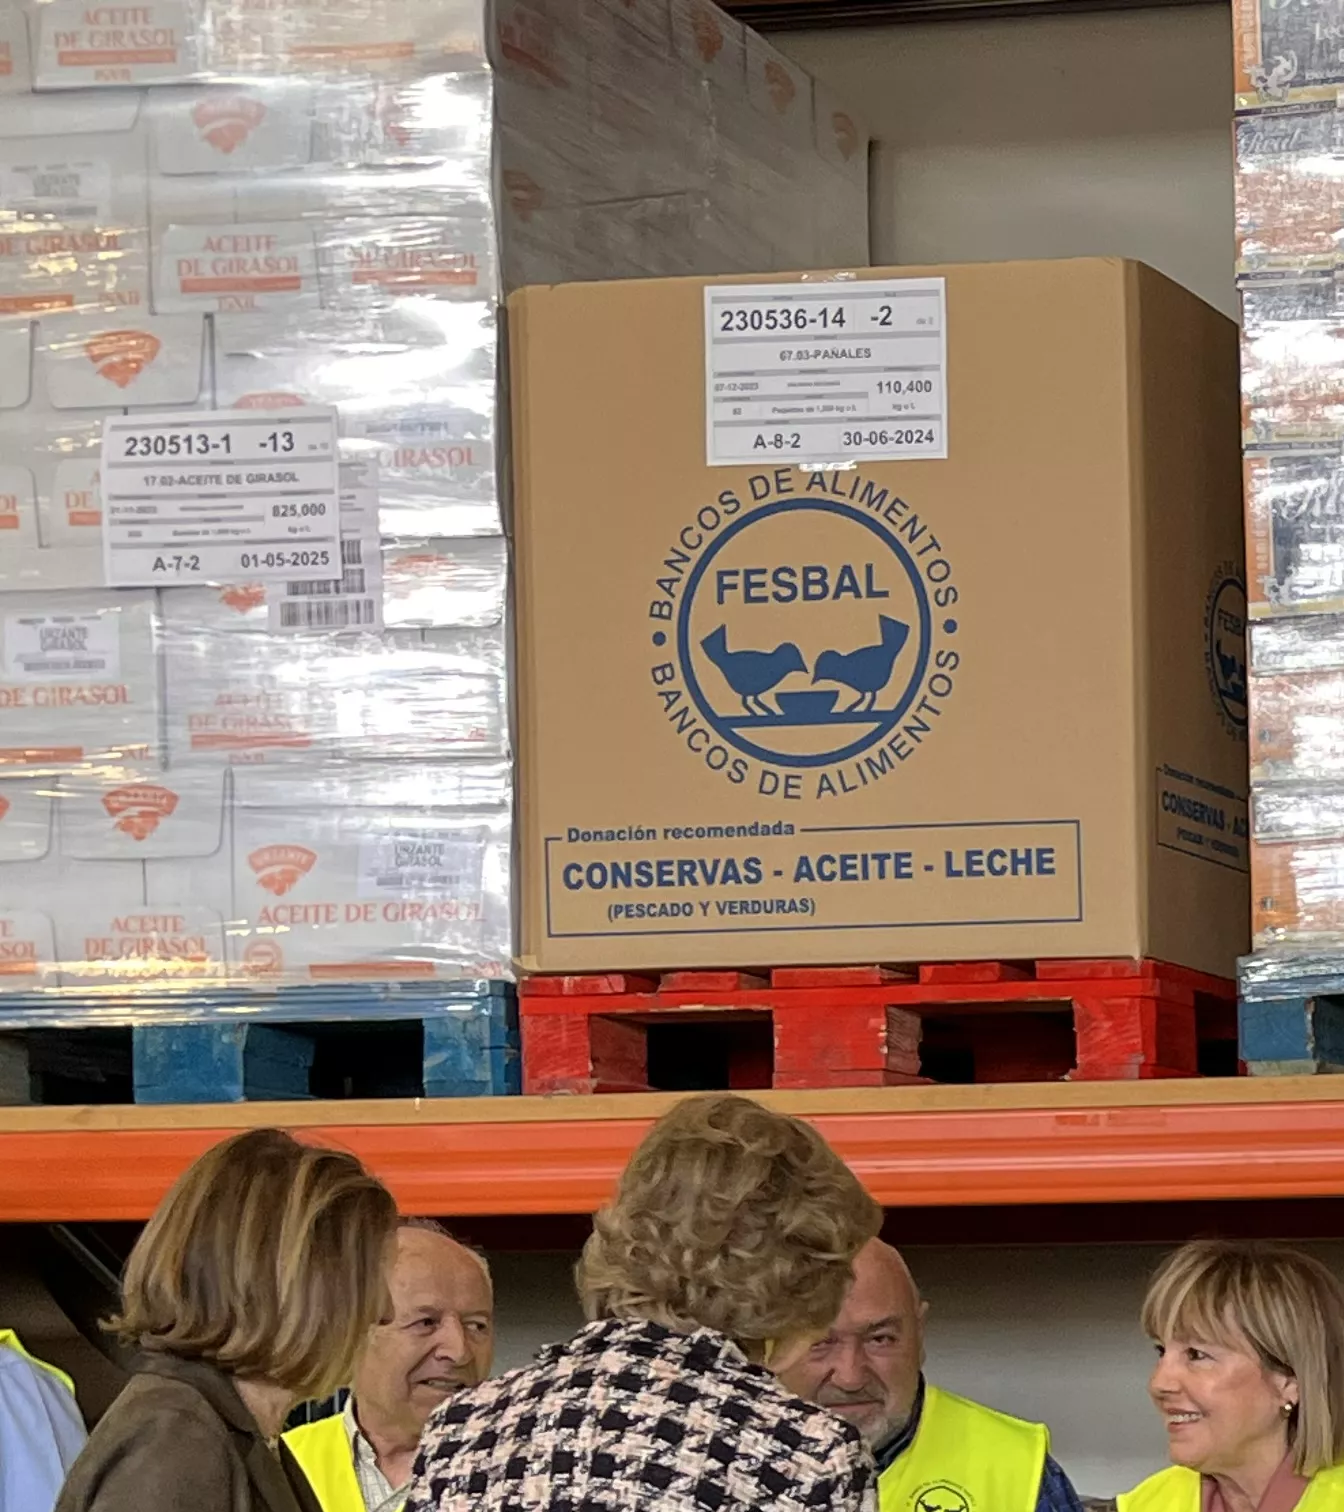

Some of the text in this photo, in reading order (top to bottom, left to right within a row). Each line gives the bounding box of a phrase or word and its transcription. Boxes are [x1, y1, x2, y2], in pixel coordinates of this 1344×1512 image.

[204, 234, 279, 253] ACEITE
[720, 306, 846, 332] 230536-14
[870, 305, 893, 327] -2
[779, 346, 872, 362] 67.03-PAÑALES
[876, 380, 933, 395] 110,400
[124, 433, 232, 457] 230513-1
[259, 431, 295, 453] -13
[753, 429, 935, 449] A-8-2 30-06-2024
[226, 473, 242, 486] DE
[245, 471, 300, 485] GIRASOL
[271, 503, 327, 518] 825,000
[649, 467, 960, 622] BANCOS DE ALIMENTOS
[152, 550, 331, 573] A-7-2 01-05-2025
[715, 562, 890, 605] FESBAL
[33, 683, 134, 707] GIRASOL
[650, 648, 961, 800] BANCOS DE ALIMENTOS
[566, 820, 796, 845] Donación recomendada
[562, 856, 764, 892] CONSERVAS
[792, 850, 914, 884] ACEITE
[944, 846, 1056, 880] LECHE
[257, 901, 487, 925] ACEITE DE GIRASOL
[606, 897, 816, 923] (PESCADO Y VERDURAS)
[111, 914, 185, 933] ACEITE
